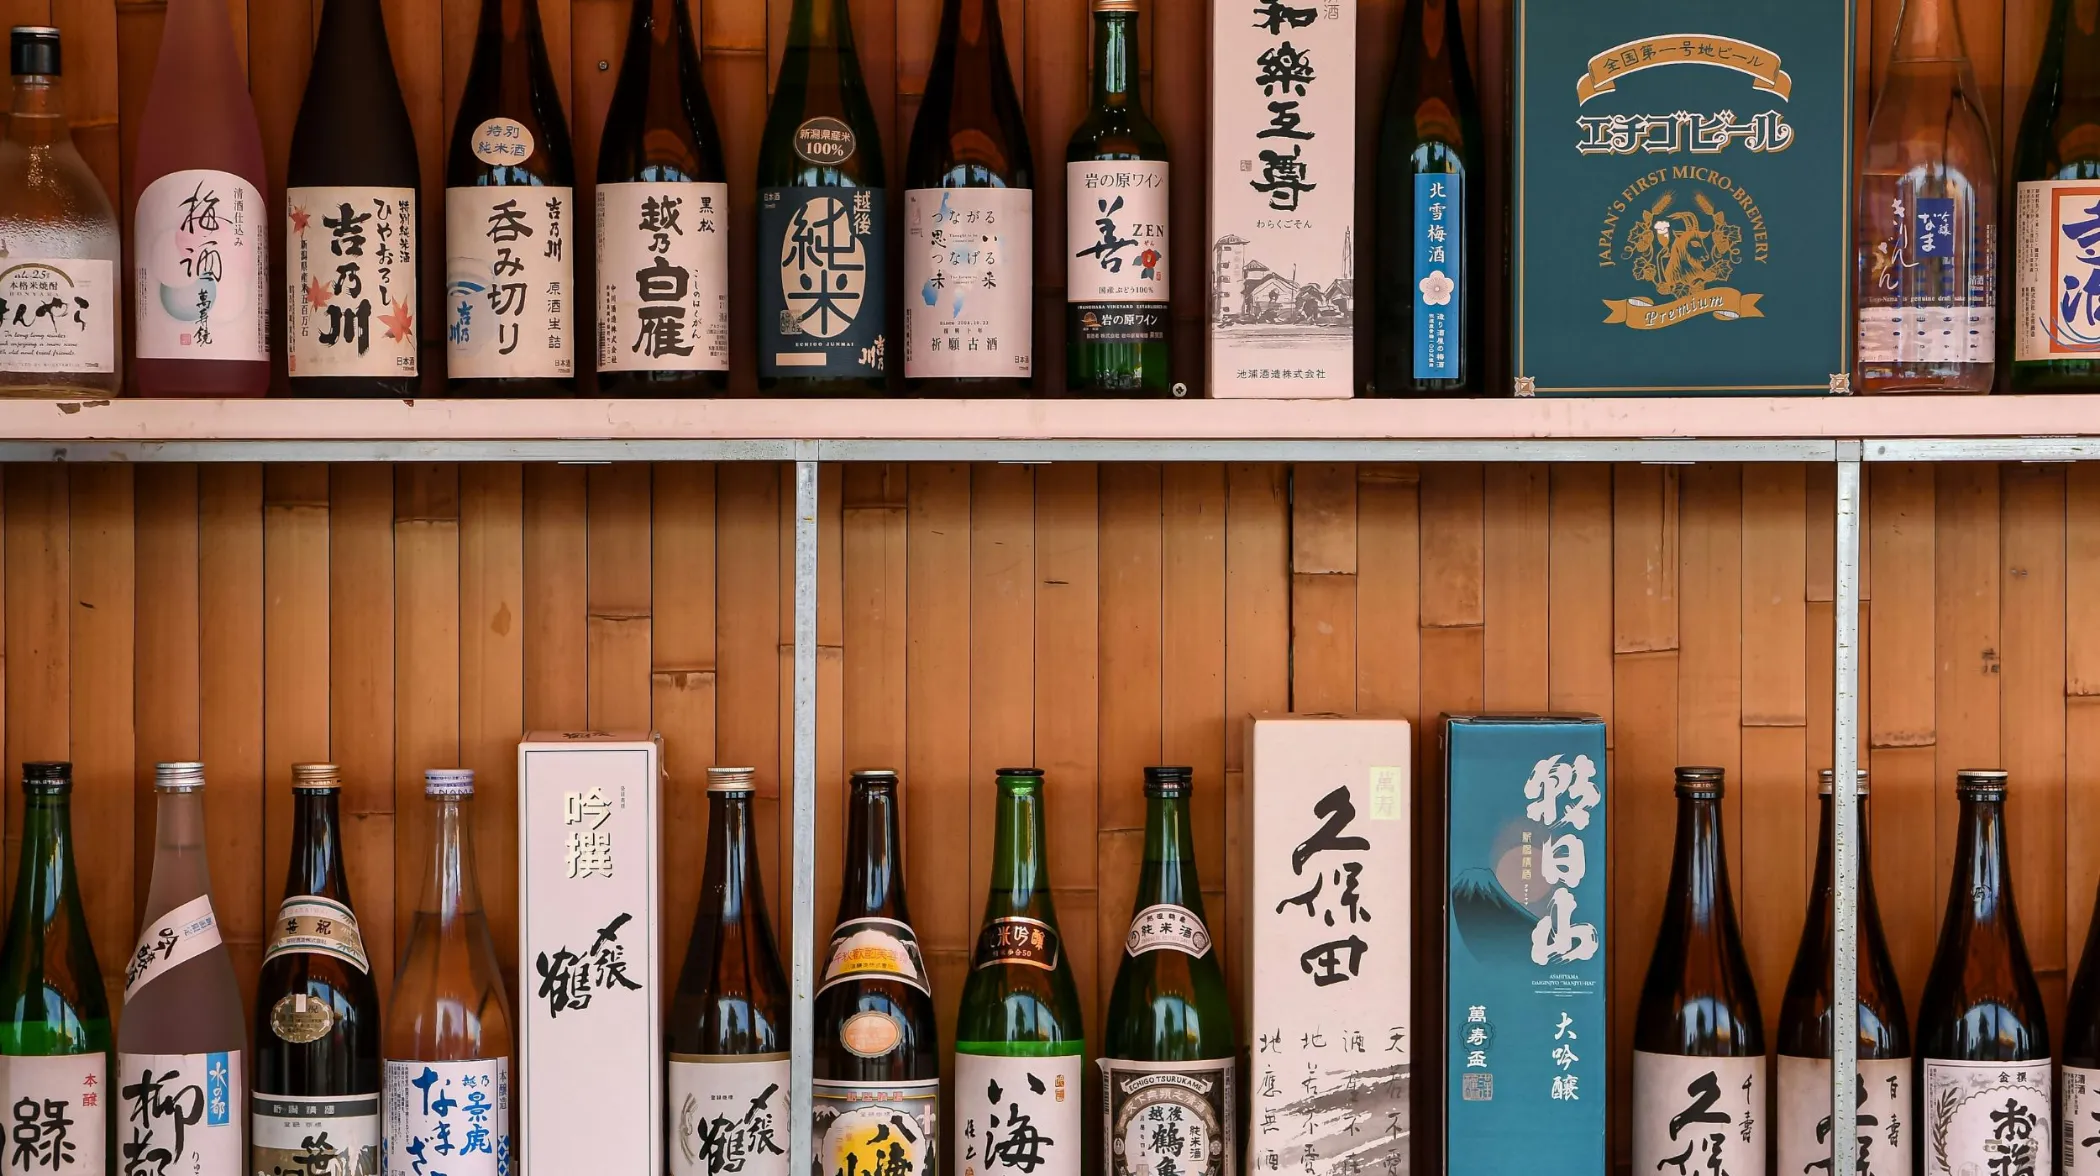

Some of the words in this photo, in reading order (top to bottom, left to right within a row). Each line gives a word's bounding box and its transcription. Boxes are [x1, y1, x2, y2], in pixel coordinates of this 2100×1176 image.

[1602, 41, 1764, 75] 全国第一号地ビール
[477, 141, 527, 157] 純米酒
[486, 125, 520, 138] 特別
[799, 128, 851, 143] 新潟県産米
[805, 142, 844, 156] 100%
[1575, 109, 1795, 156] エチゴビール
[1085, 172, 1164, 188] 岩の原ワイン
[233, 187, 244, 247] 清酒仕込み
[543, 197, 563, 262] 吉乃川
[697, 197, 715, 233] 黒松
[854, 190, 871, 235] 越後
[932, 210, 995, 225] つながる
[1132, 224, 1164, 237] ZEN
[1256, 219, 1312, 229] わらくごそん
[1428, 182, 1447, 263] 北雪梅酒
[1598, 201, 1627, 268] JAPAN'S
[1621, 168, 1668, 203] FIRST
[1672, 165, 1770, 264] MICRO-BREWERY
[178, 181, 233, 282] 梅酒
[398, 200, 410, 264] 特別純米酒
[1076, 195, 1139, 273] 善
[1917, 213, 1937, 252] なま
[373, 198, 394, 306] ひやおろし
[782, 197, 864, 336] 純米
[932, 251, 996, 265] つなげる
[9, 281, 58, 291] 本格米焼酎
[318, 203, 373, 358] 吉乃川
[486, 199, 534, 355] 呑み切り
[632, 195, 695, 359] 越乃白雁
[0, 296, 90, 333] んやら
[449, 300, 474, 345] 吉乃川
[546, 282, 562, 349] 原酒生詰
[691, 269, 703, 339] こしのはくがん
[1101, 314, 1158, 326] 岩の原ワイン
[1644, 295, 1725, 327] Premium
[931, 337, 998, 351] 祈願古酒
[1236, 369, 1326, 380] 池浦酒造株式会社
[564, 786, 613, 879] 吟撰
[1276, 785, 1372, 987] 久保田
[989, 925, 1046, 951] 米吟醸
[1141, 922, 1193, 939] 純米酒
[1551, 1011, 1579, 1101] 大吟醸
[82, 1073, 98, 1107] 本醸
[209, 1060, 228, 1121] 水の都
[1128, 1076, 1155, 1092] ECHIGO
[1156, 1075, 1203, 1091] TSURUKAME
[2077, 1074, 2085, 1095] 清酒
[459, 1091, 493, 1156] 景虎
[1148, 1105, 1185, 1121] 越後
[1189, 1125, 1201, 1159] 純米酒
